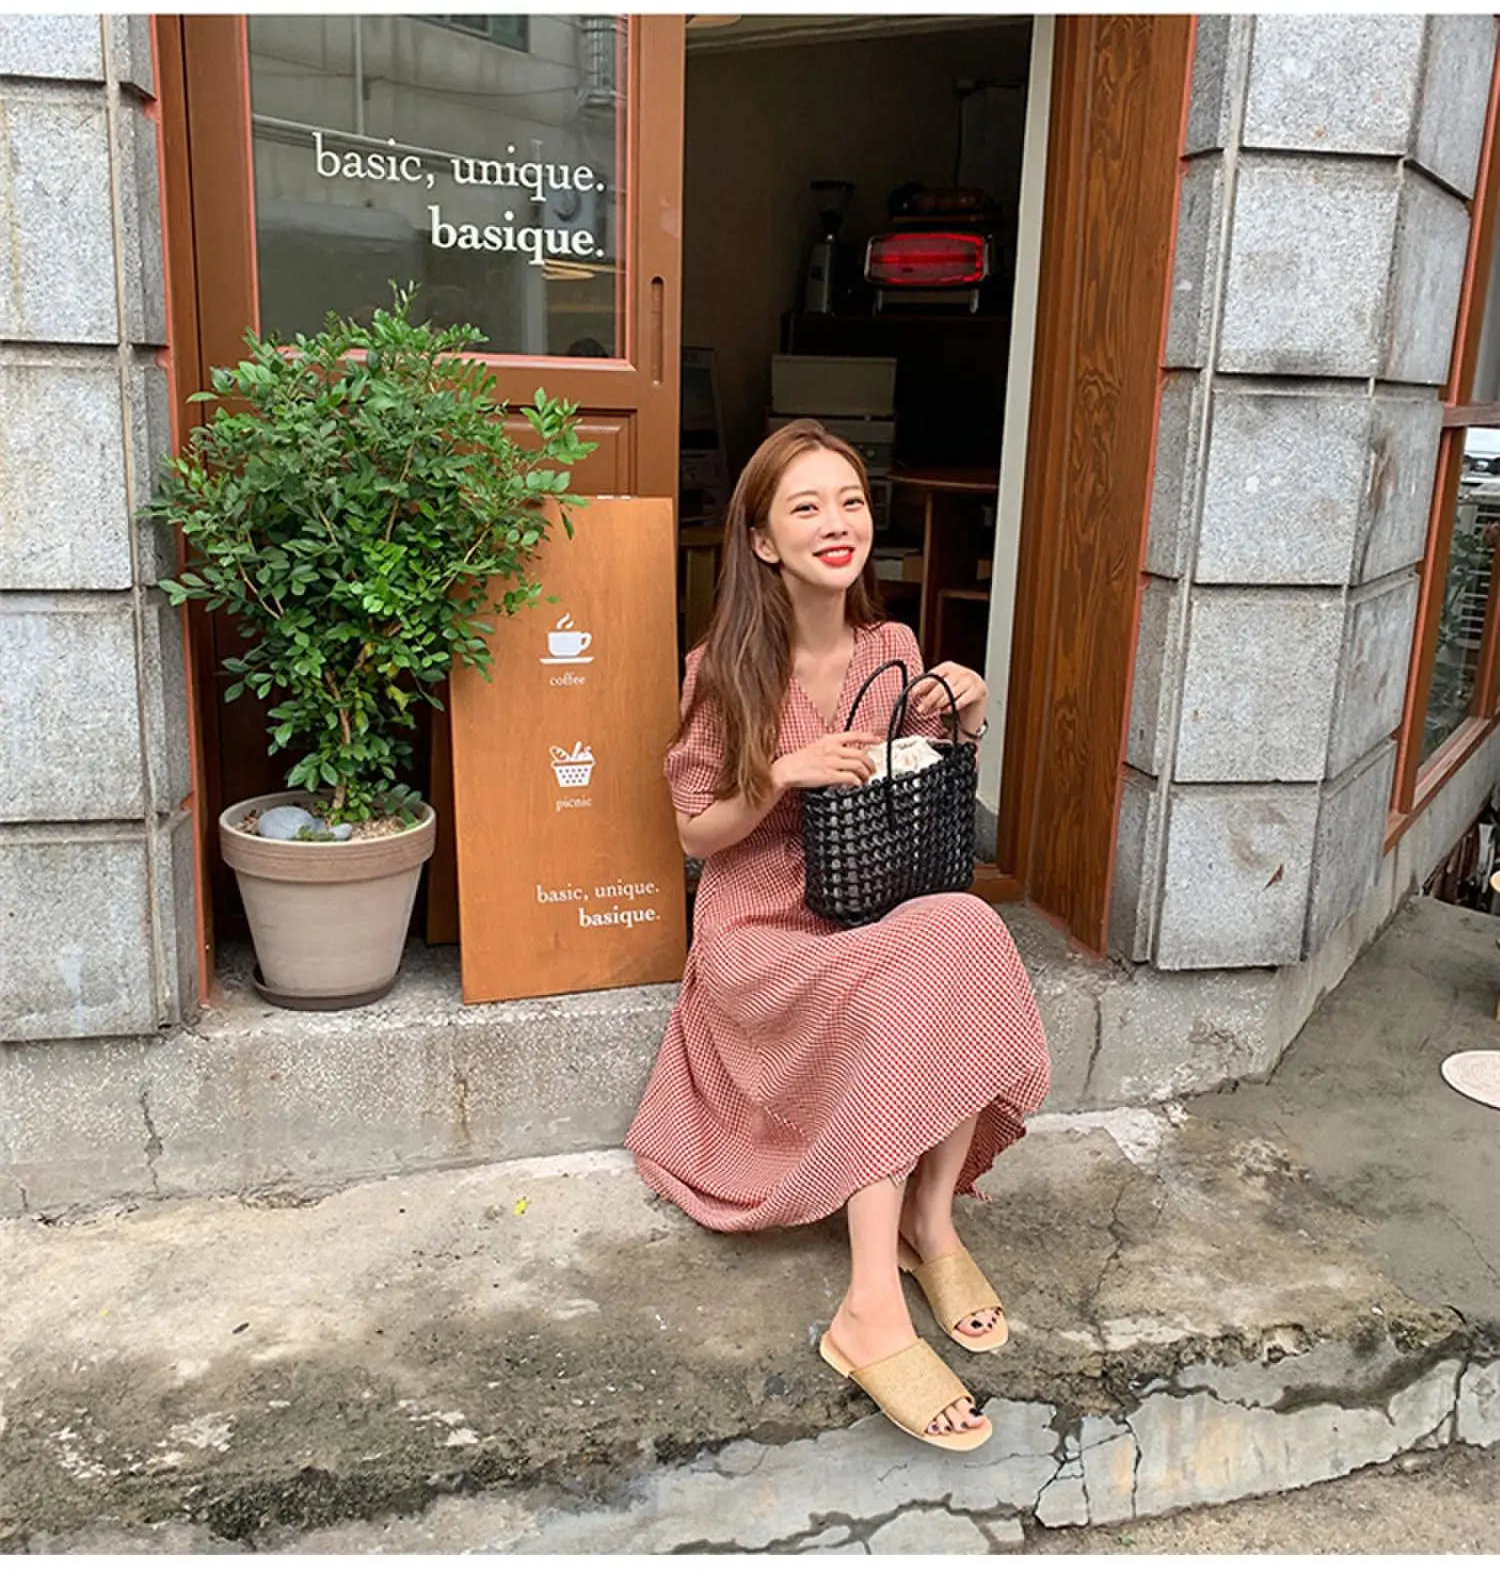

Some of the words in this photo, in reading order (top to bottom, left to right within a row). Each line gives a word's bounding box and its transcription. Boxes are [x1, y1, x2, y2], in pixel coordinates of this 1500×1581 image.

[312, 132, 435, 188] basic,
[451, 145, 605, 202] unique.
[427, 204, 604, 265] basique.
[549, 671, 586, 686] coffee
[555, 795, 593, 813] picnic
[536, 882, 589, 904] basic,
[594, 878, 660, 900] unique.
[578, 904, 661, 929] basique.
